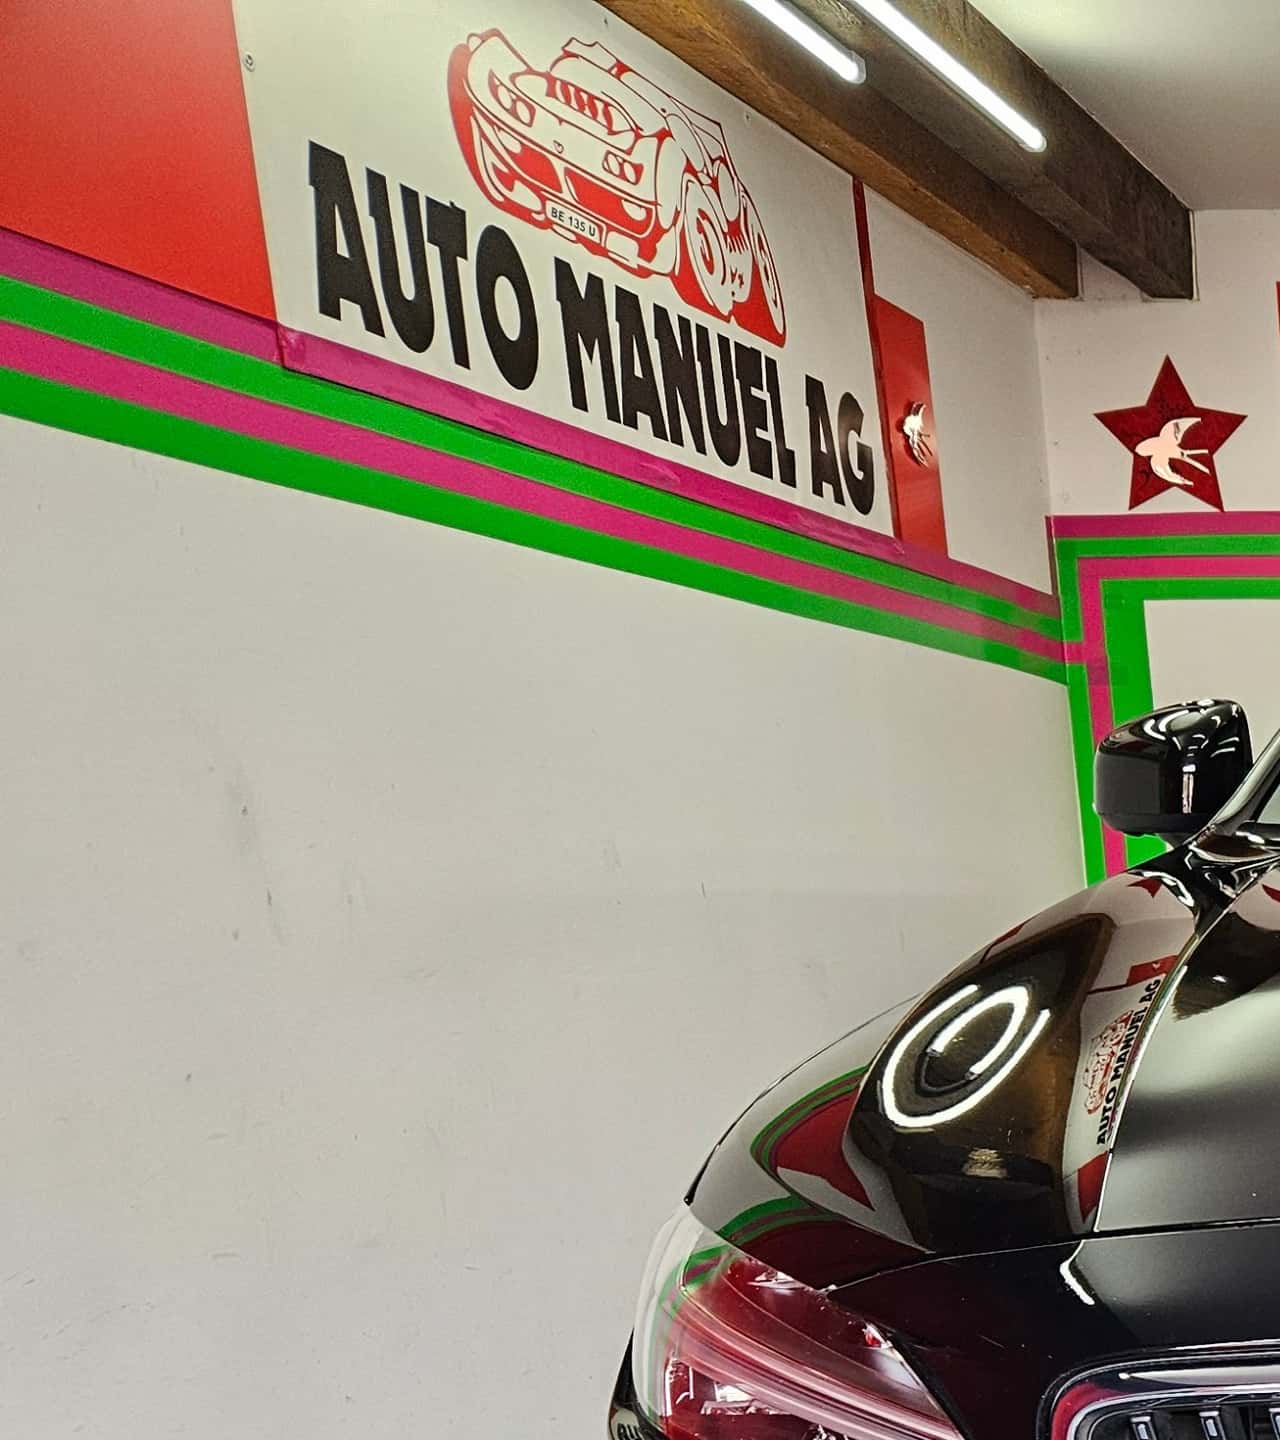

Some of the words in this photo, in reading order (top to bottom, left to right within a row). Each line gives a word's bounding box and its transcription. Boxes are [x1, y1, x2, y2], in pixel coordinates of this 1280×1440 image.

[551, 206, 565, 222] BE
[568, 216, 586, 232] 135
[589, 226, 596, 237] U
[309, 141, 539, 390] AUTO
[555, 257, 797, 489] MANUEL
[806, 375, 876, 516] AG
[1096, 1086, 1117, 1146] AUTO
[1110, 1007, 1148, 1082] MANUEL
[1138, 978, 1161, 1004] AG
